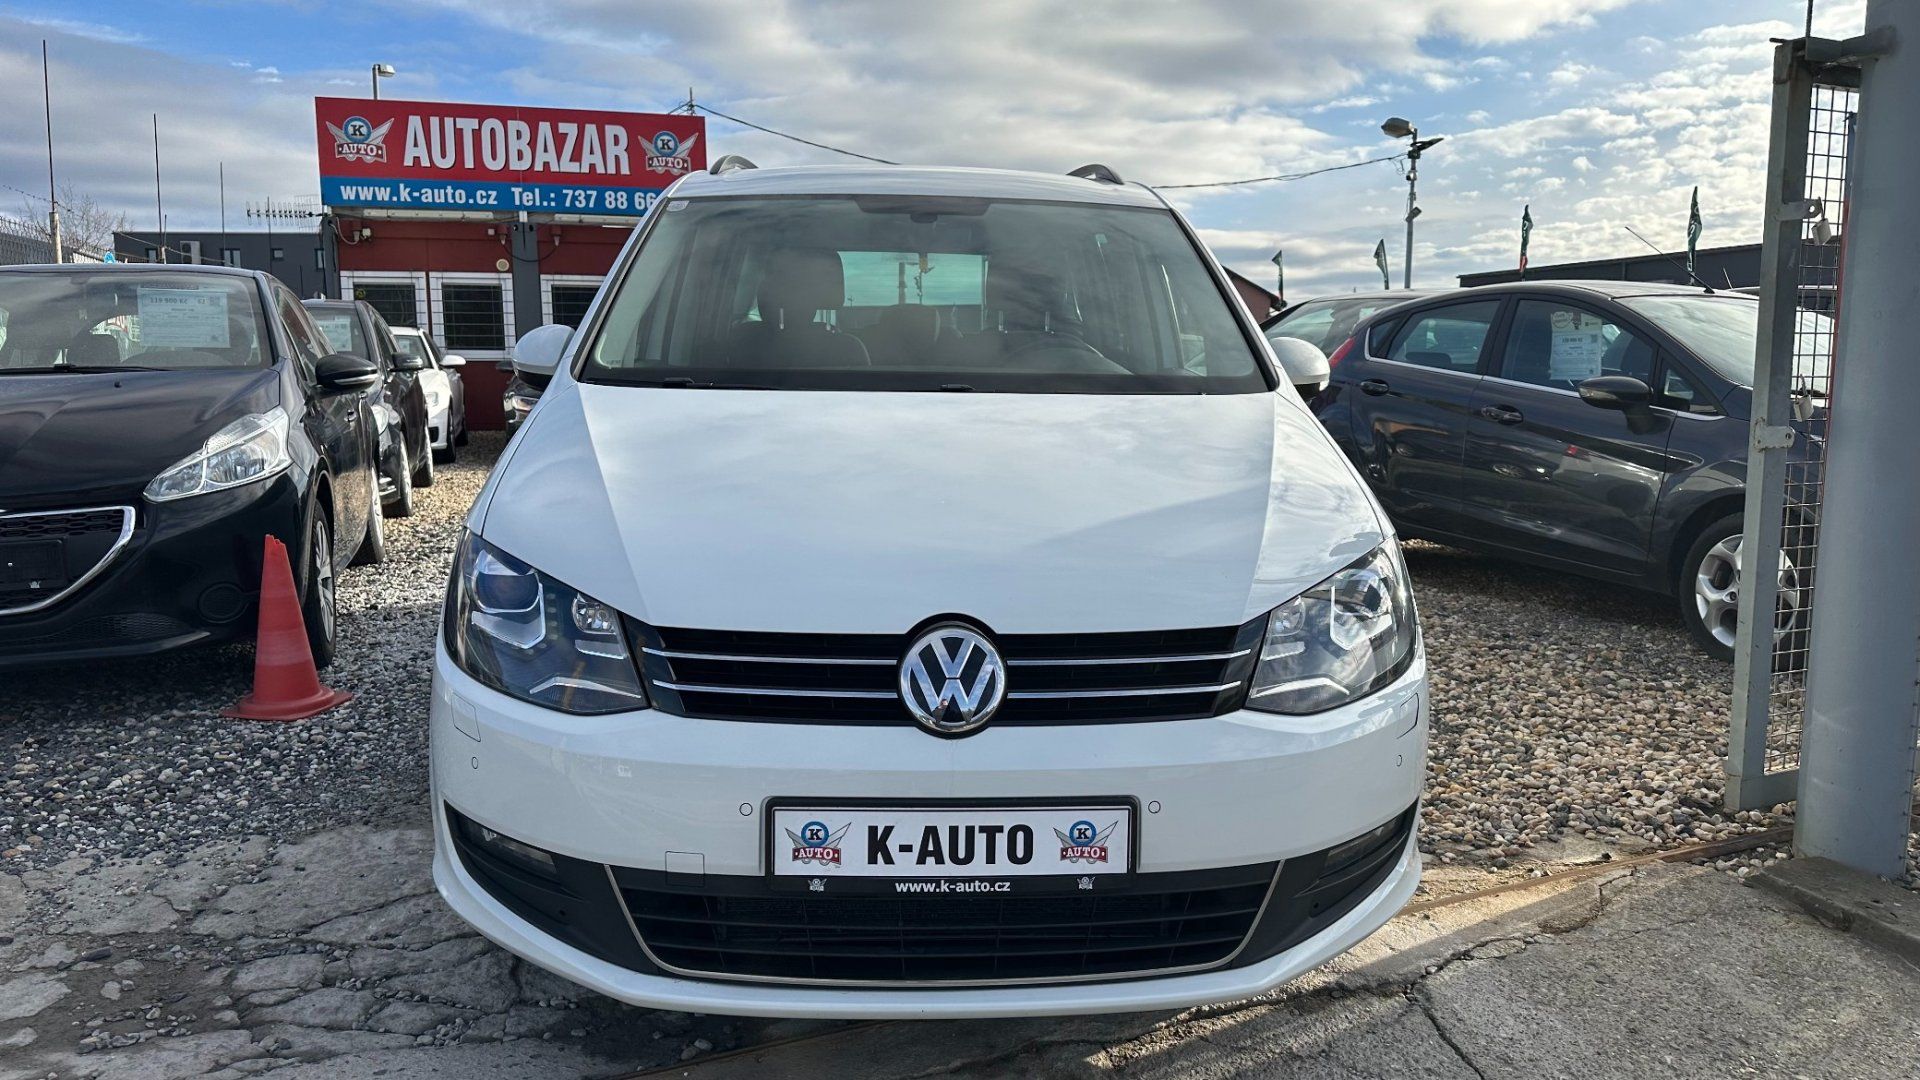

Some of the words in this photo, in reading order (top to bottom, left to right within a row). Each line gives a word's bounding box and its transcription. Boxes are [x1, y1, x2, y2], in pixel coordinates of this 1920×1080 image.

[350, 124, 365, 136] K
[341, 143, 377, 156] AUTO
[403, 115, 631, 175] AUTOBAZAR
[660, 139, 672, 150] K
[652, 157, 683, 169] AUTO
[340, 183, 498, 205] www.k-auto.cz
[511, 187, 556, 207] Tel.:
[562, 189, 598, 208] 737
[604, 191, 628, 210] 88
[808, 828, 822, 840] K
[1076, 827, 1090, 839] K
[867, 824, 1034, 866] K-AUTO
[798, 848, 833, 860] AUTO
[1066, 846, 1100, 858] AUTO
[895, 880, 1011, 893] www.k-auto.cz
